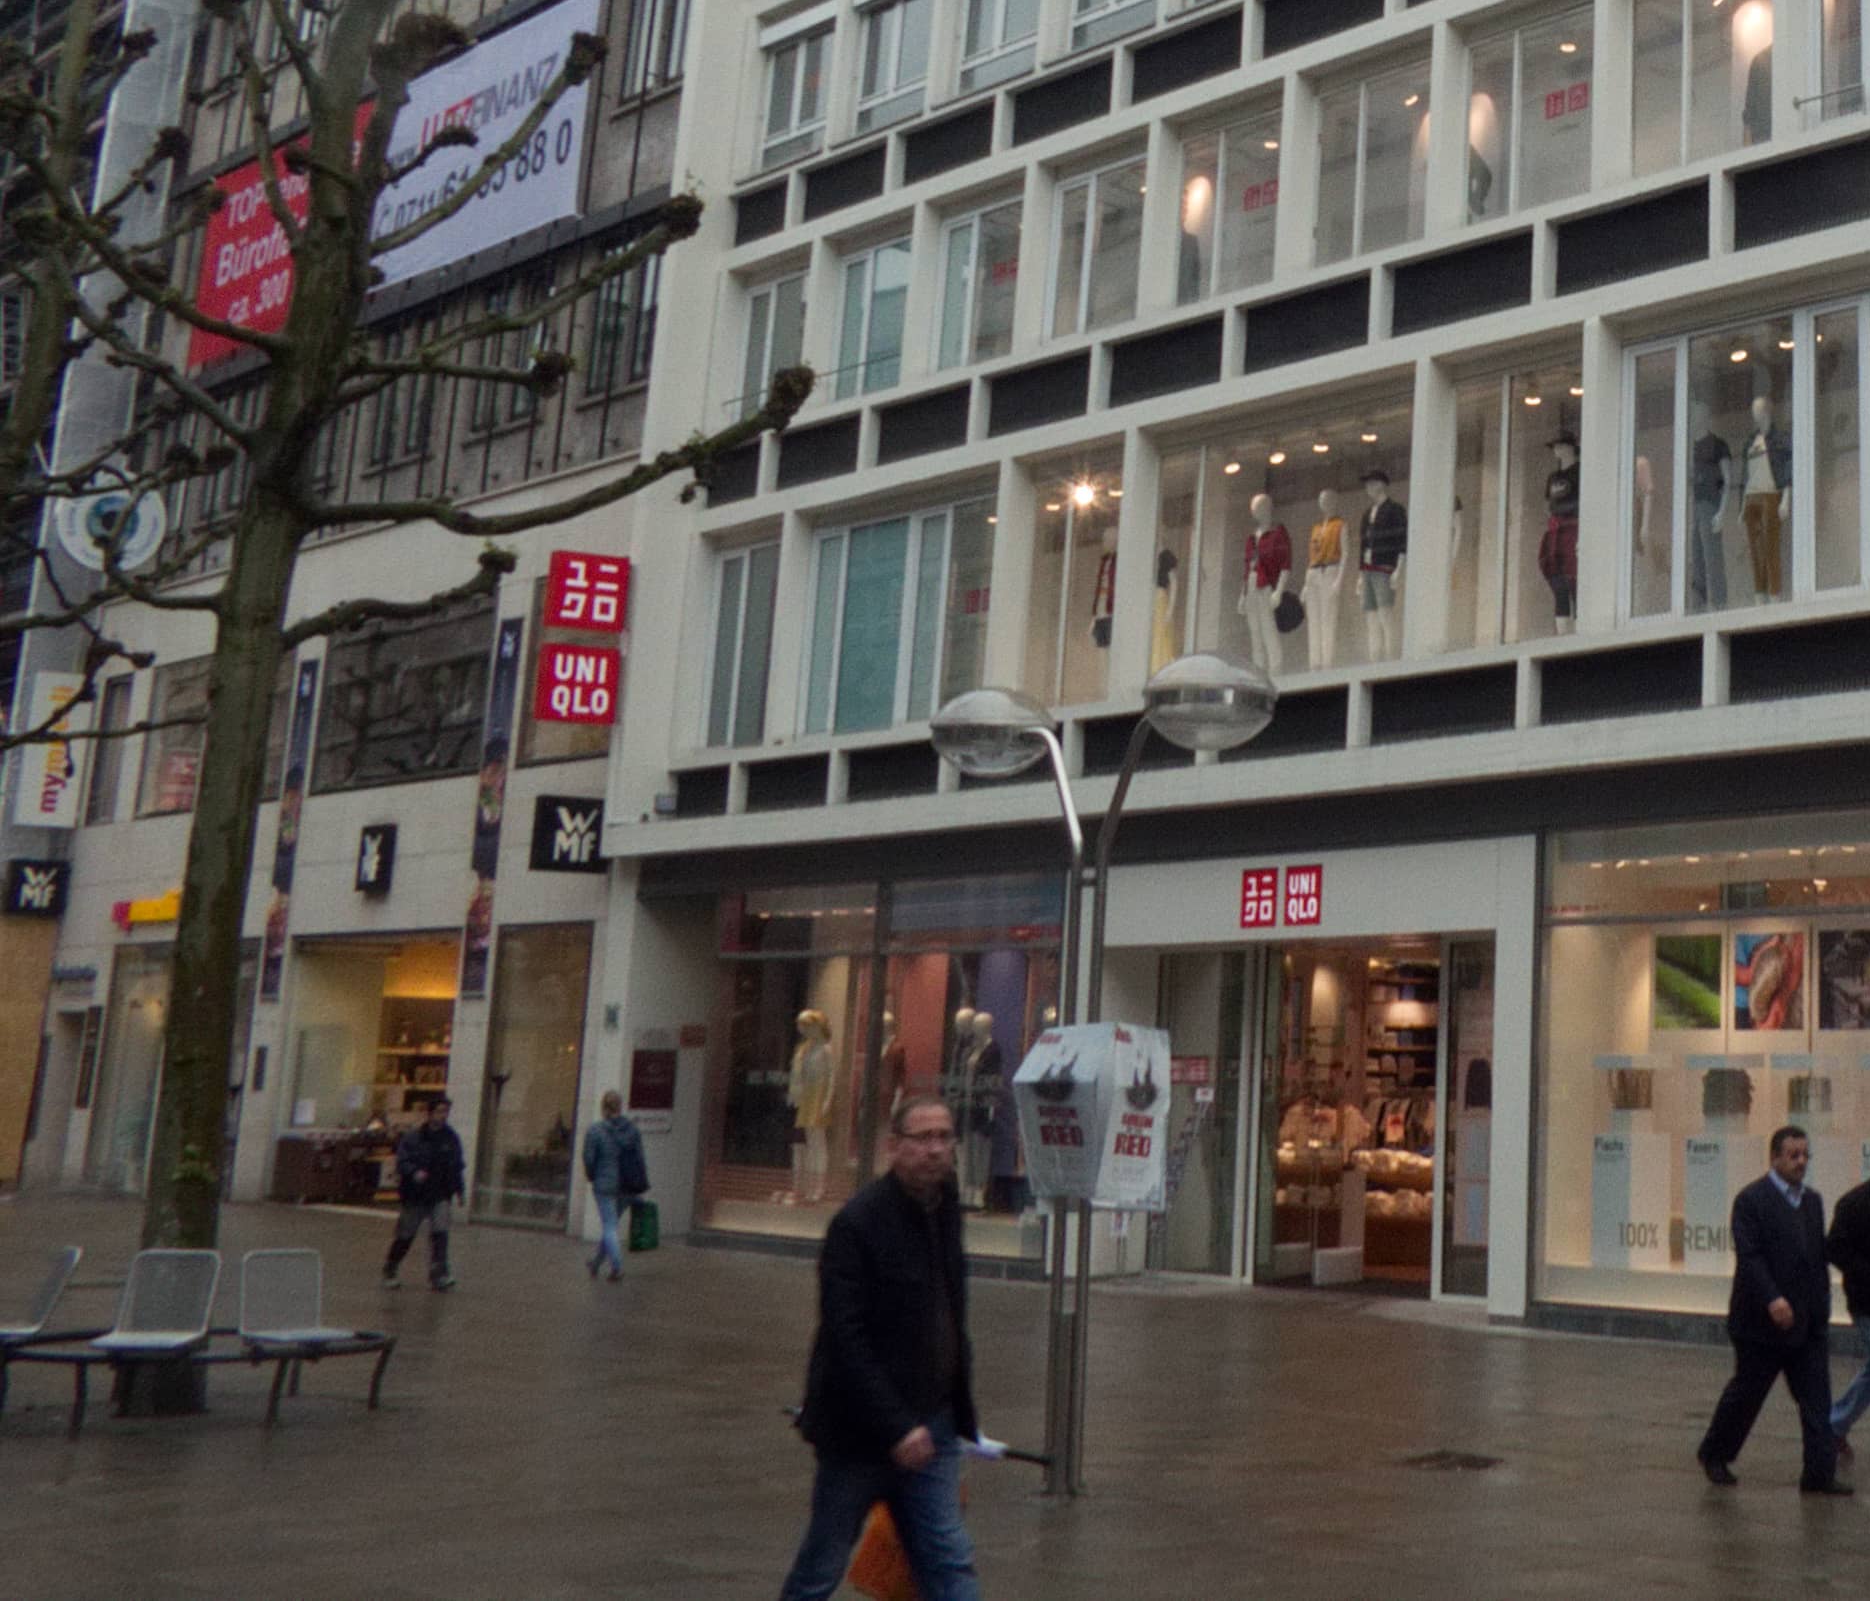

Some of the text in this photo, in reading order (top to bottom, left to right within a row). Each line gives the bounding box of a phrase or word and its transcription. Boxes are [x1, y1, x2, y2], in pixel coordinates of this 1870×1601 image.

[554, 653, 607, 684] UNI
[551, 684, 609, 717] QLO
[1289, 872, 1316, 895] UNI
[1287, 896, 1318, 923] QLO
[1114, 1133, 1151, 1158] RED
